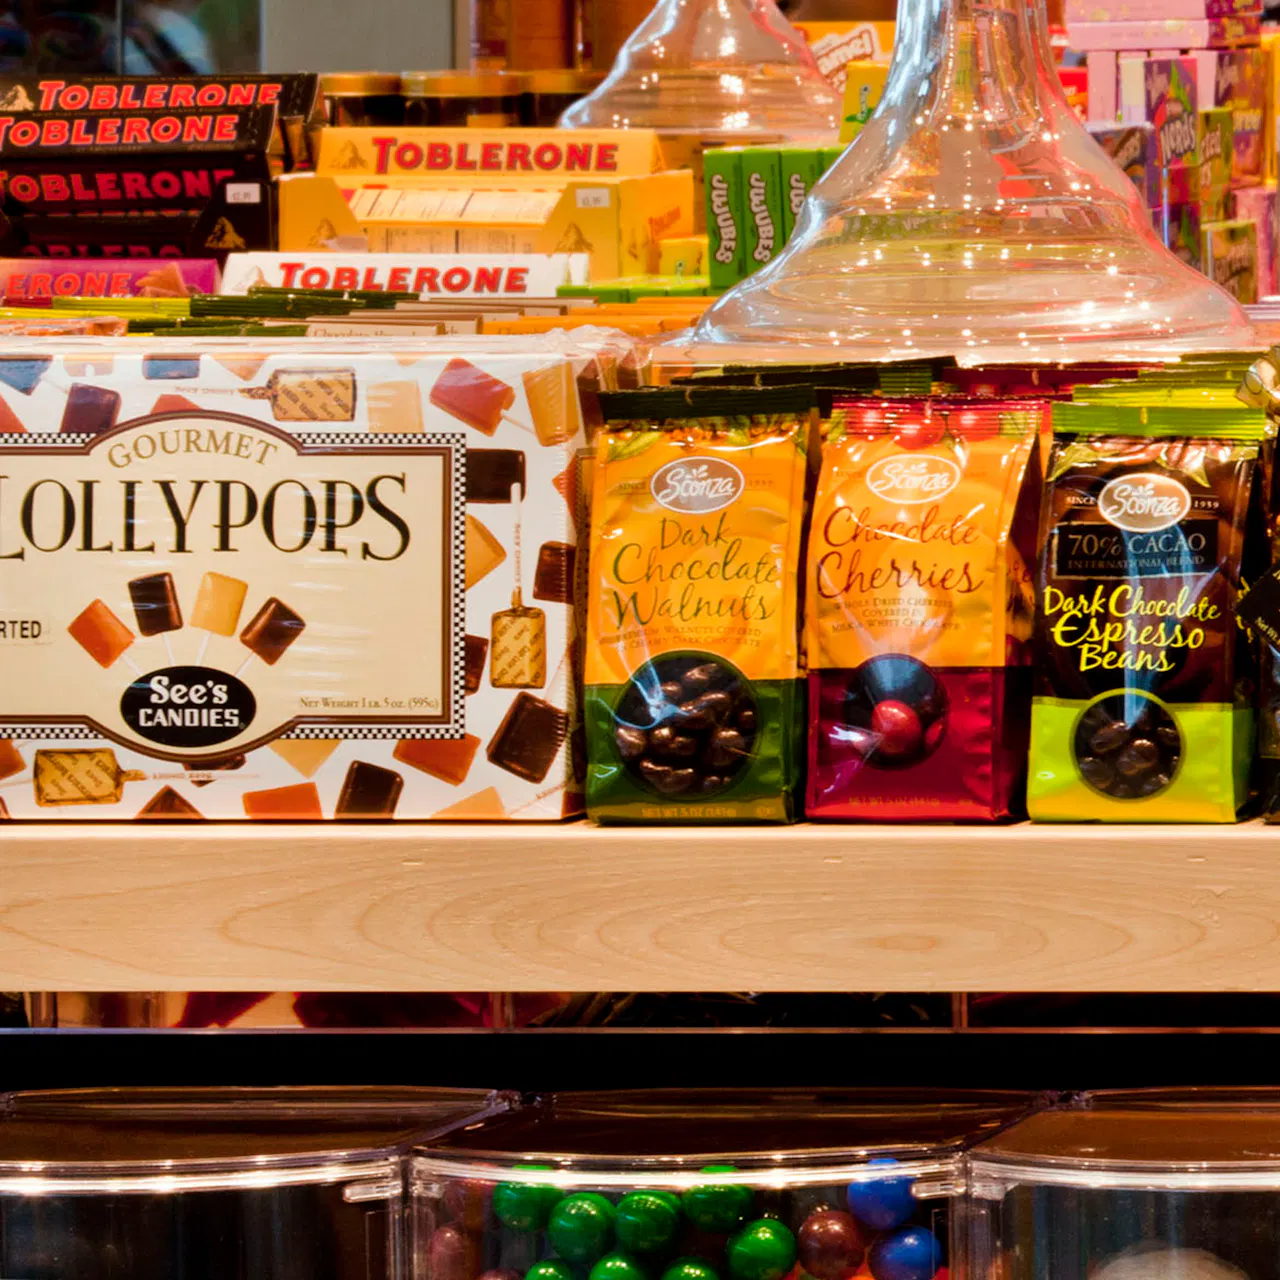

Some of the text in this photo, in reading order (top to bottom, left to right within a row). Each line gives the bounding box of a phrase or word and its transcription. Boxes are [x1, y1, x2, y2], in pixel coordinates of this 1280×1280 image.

[39, 81, 282, 112] TOBLERONE
[372, 137, 619, 175] TOBLERONE
[279, 262, 529, 294] TOBLERONE
[107, 428, 279, 470] GOURMET
[661, 511, 730, 550] Dark
[824, 504, 980, 547] Chocolate
[613, 537, 780, 585] Chocolate
[1068, 532, 1206, 560] 70% CACAO
[816, 548, 985, 599] Cherries
[613, 582, 776, 631] Walnuts
[1044, 584, 1221, 622] Dark Chocolate
[1050, 610, 1205, 654] Espresso
[1078, 643, 1176, 672] Beans
[149, 675, 229, 706] See's
[300, 697, 319, 709] NET
[384, 697, 391, 708] 5
[138, 707, 241, 728] CANDIES
